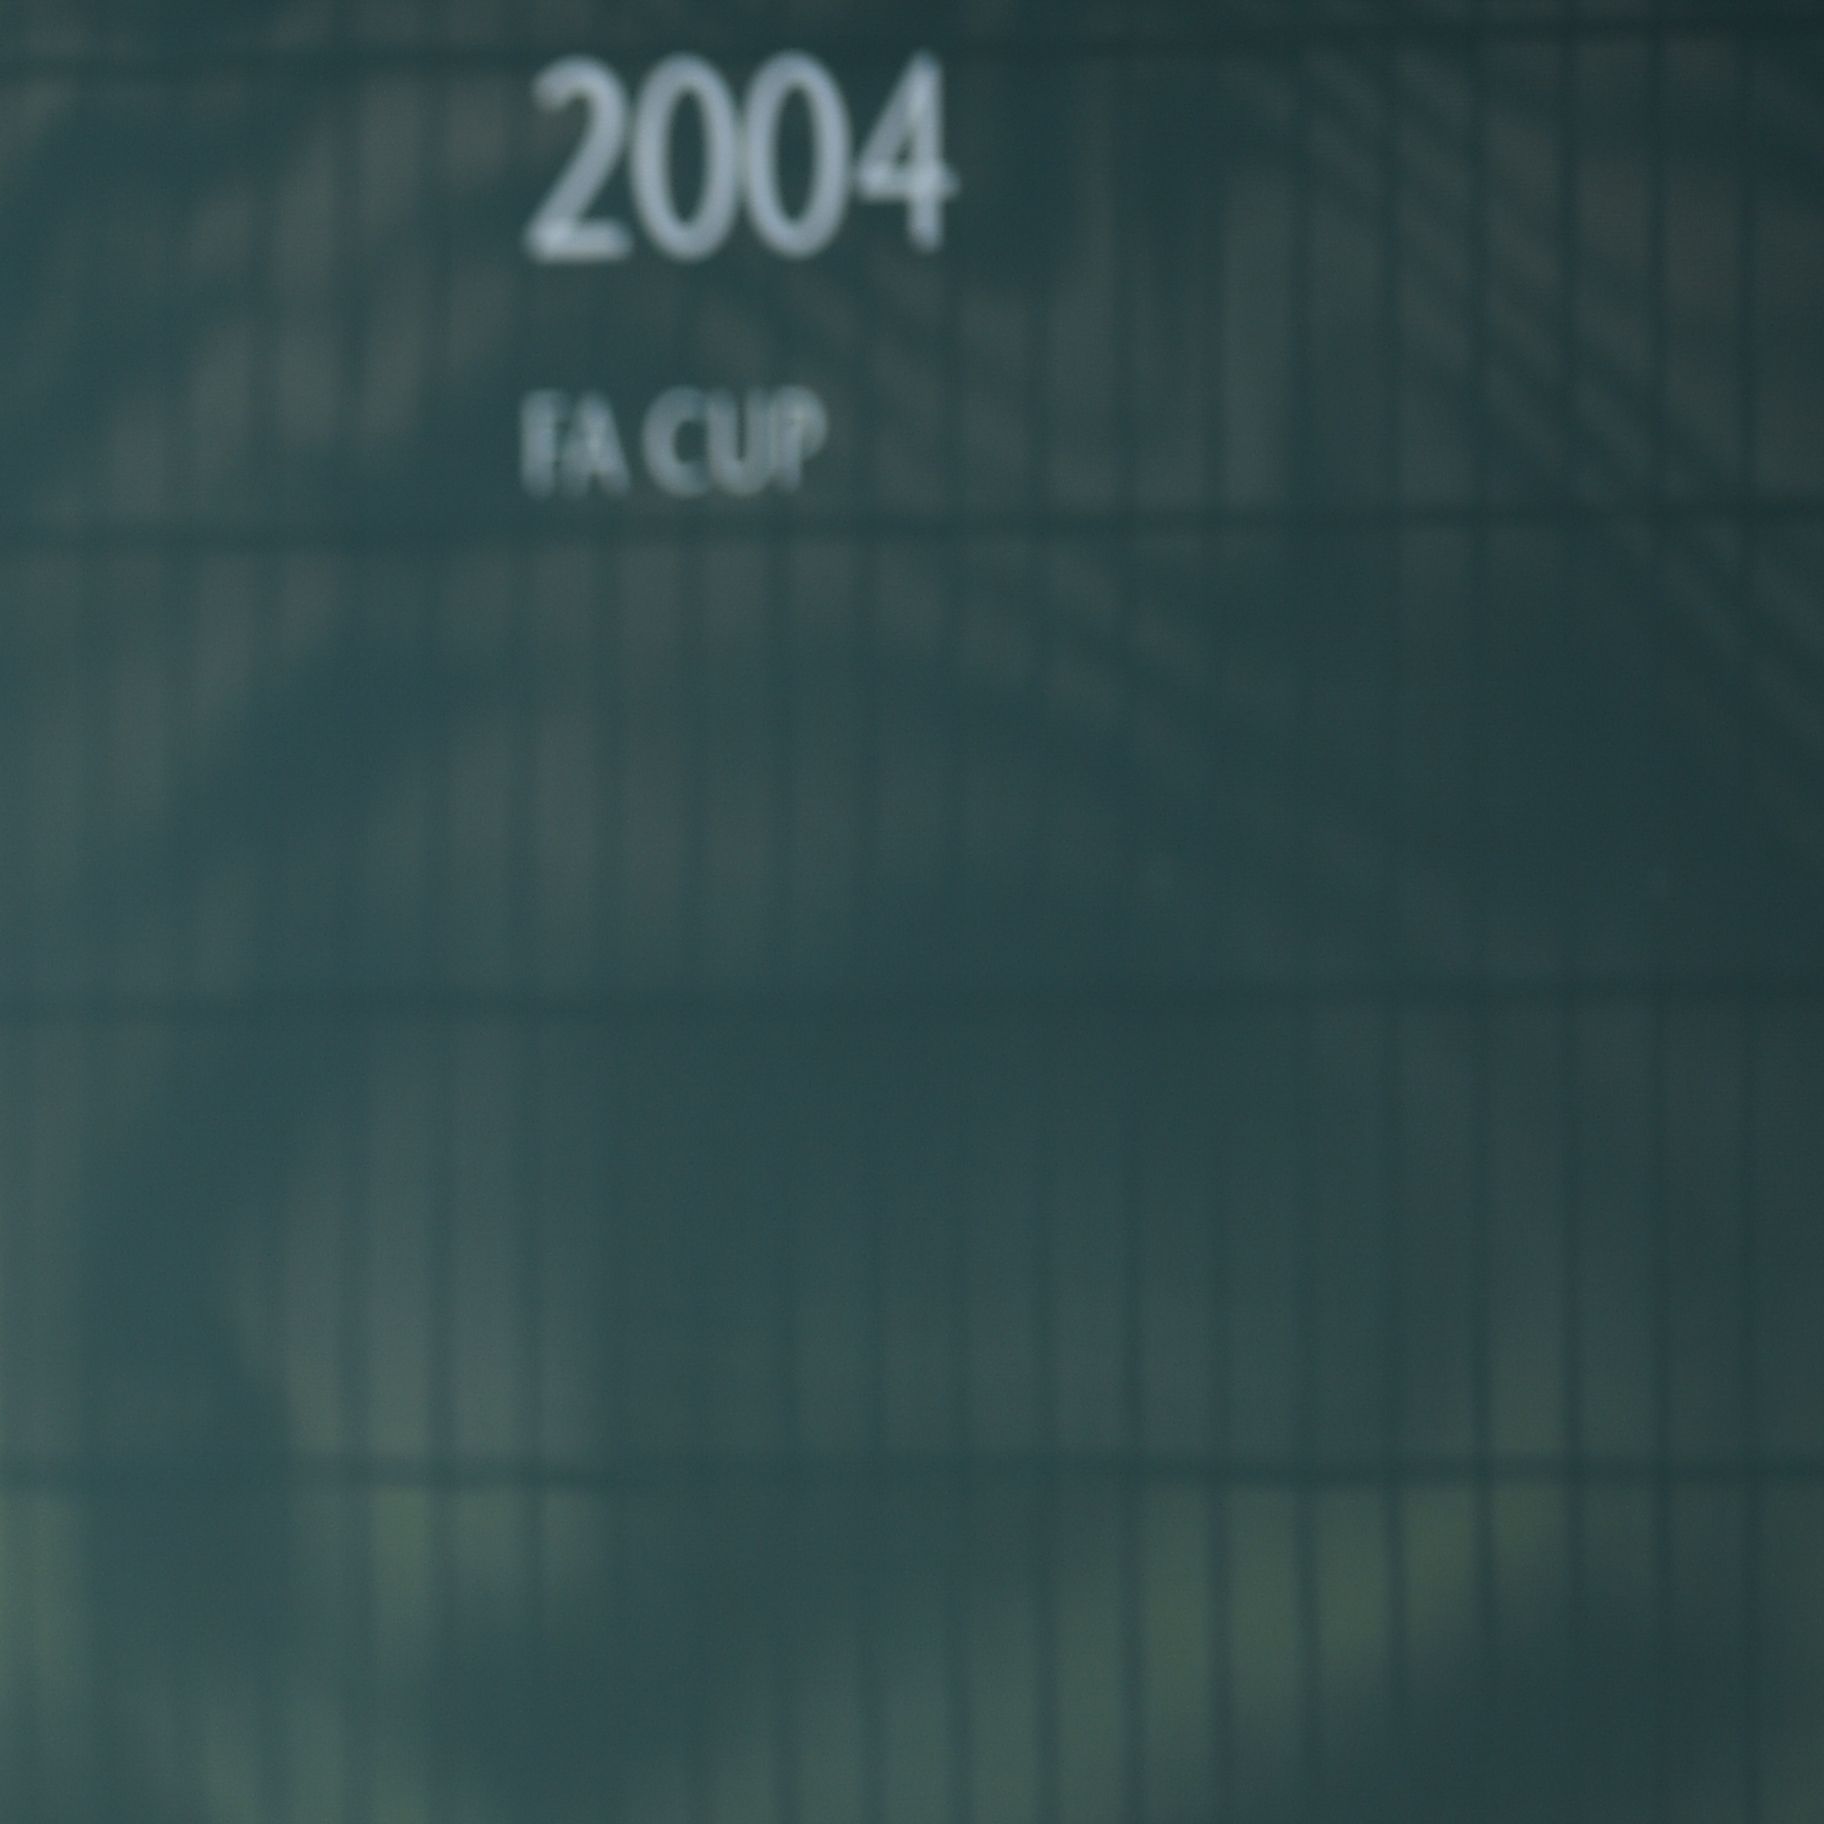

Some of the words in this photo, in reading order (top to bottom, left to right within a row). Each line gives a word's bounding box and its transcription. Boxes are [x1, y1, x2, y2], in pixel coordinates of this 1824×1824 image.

[526, 50, 958, 261] 2004
[520, 389, 631, 496] FA
[641, 385, 827, 496] CUP
